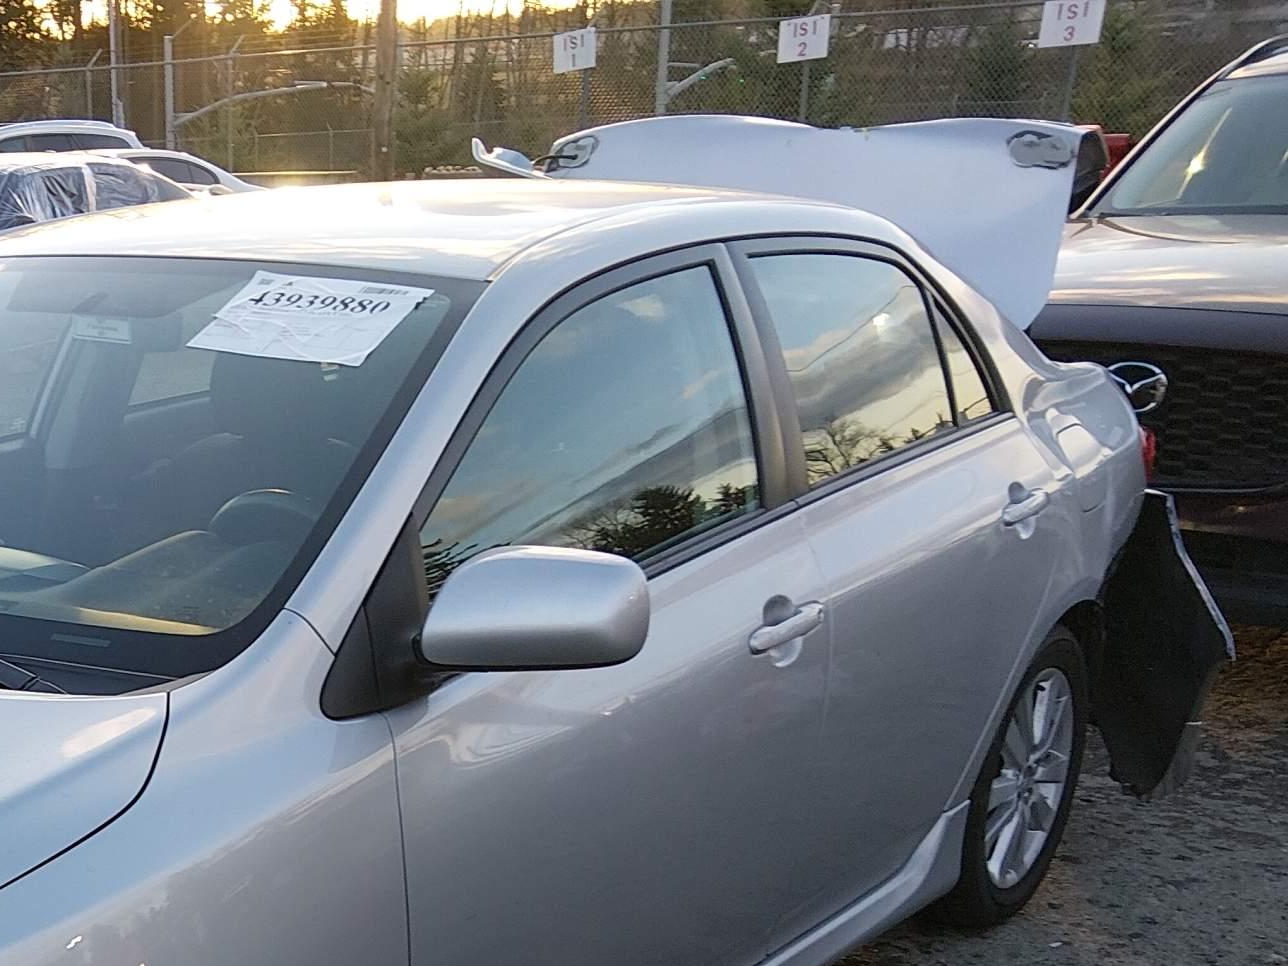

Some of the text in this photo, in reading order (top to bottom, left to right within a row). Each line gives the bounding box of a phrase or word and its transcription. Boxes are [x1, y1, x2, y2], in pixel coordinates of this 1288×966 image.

[1063, 25, 1076, 42] 3
[797, 41, 808, 57] 2
[248, 290, 391, 315] 43939880
